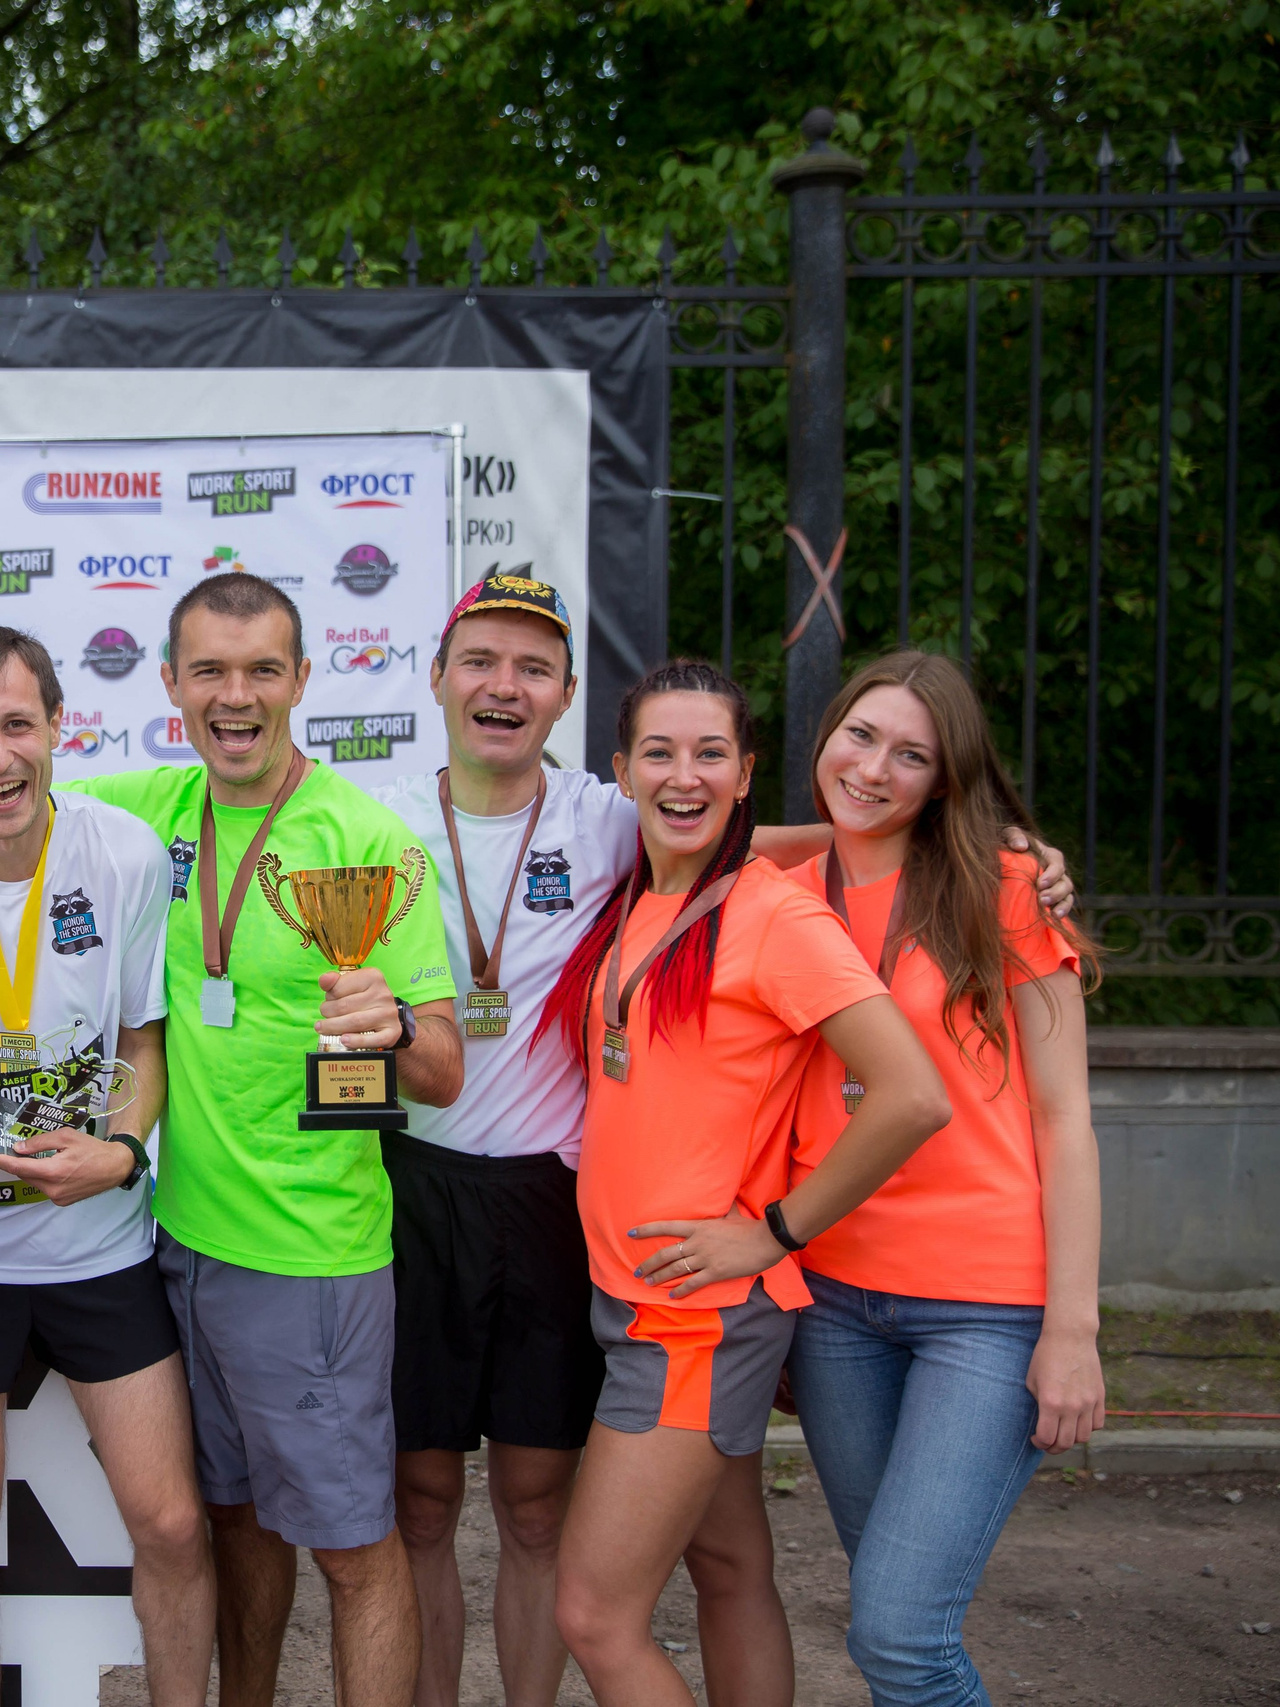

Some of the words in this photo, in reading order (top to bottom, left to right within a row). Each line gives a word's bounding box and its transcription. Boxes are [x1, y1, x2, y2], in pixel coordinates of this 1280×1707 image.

[48, 472, 162, 498] RUNZONE
[189, 471, 292, 496] WORK&SPORT
[321, 474, 415, 496] ФРОСТ
[216, 492, 270, 514] RUN
[79, 555, 172, 577] ФРОСТ
[326, 628, 356, 643] Red
[360, 628, 389, 642] Bull
[73, 712, 102, 725] Bull
[308, 716, 411, 742] WORK&SPORT
[336, 738, 389, 761] RUN
[536, 876, 561, 887] HONOR
[532, 887, 544, 896] THE
[545, 886, 566, 896] SPORT
[62, 916, 86, 929] HONOR
[59, 930, 71, 940] THE
[72, 924, 93, 936] SPORT
[424, 966, 447, 978] asics
[462, 1007, 512, 1019] WORK&SPORT
[474, 1023, 499, 1033] RUN
[3, 1076, 29, 1086] ЗАБЕГ
[110, 1079, 124, 1091] 1
[37, 1104, 74, 1122] WORK&
